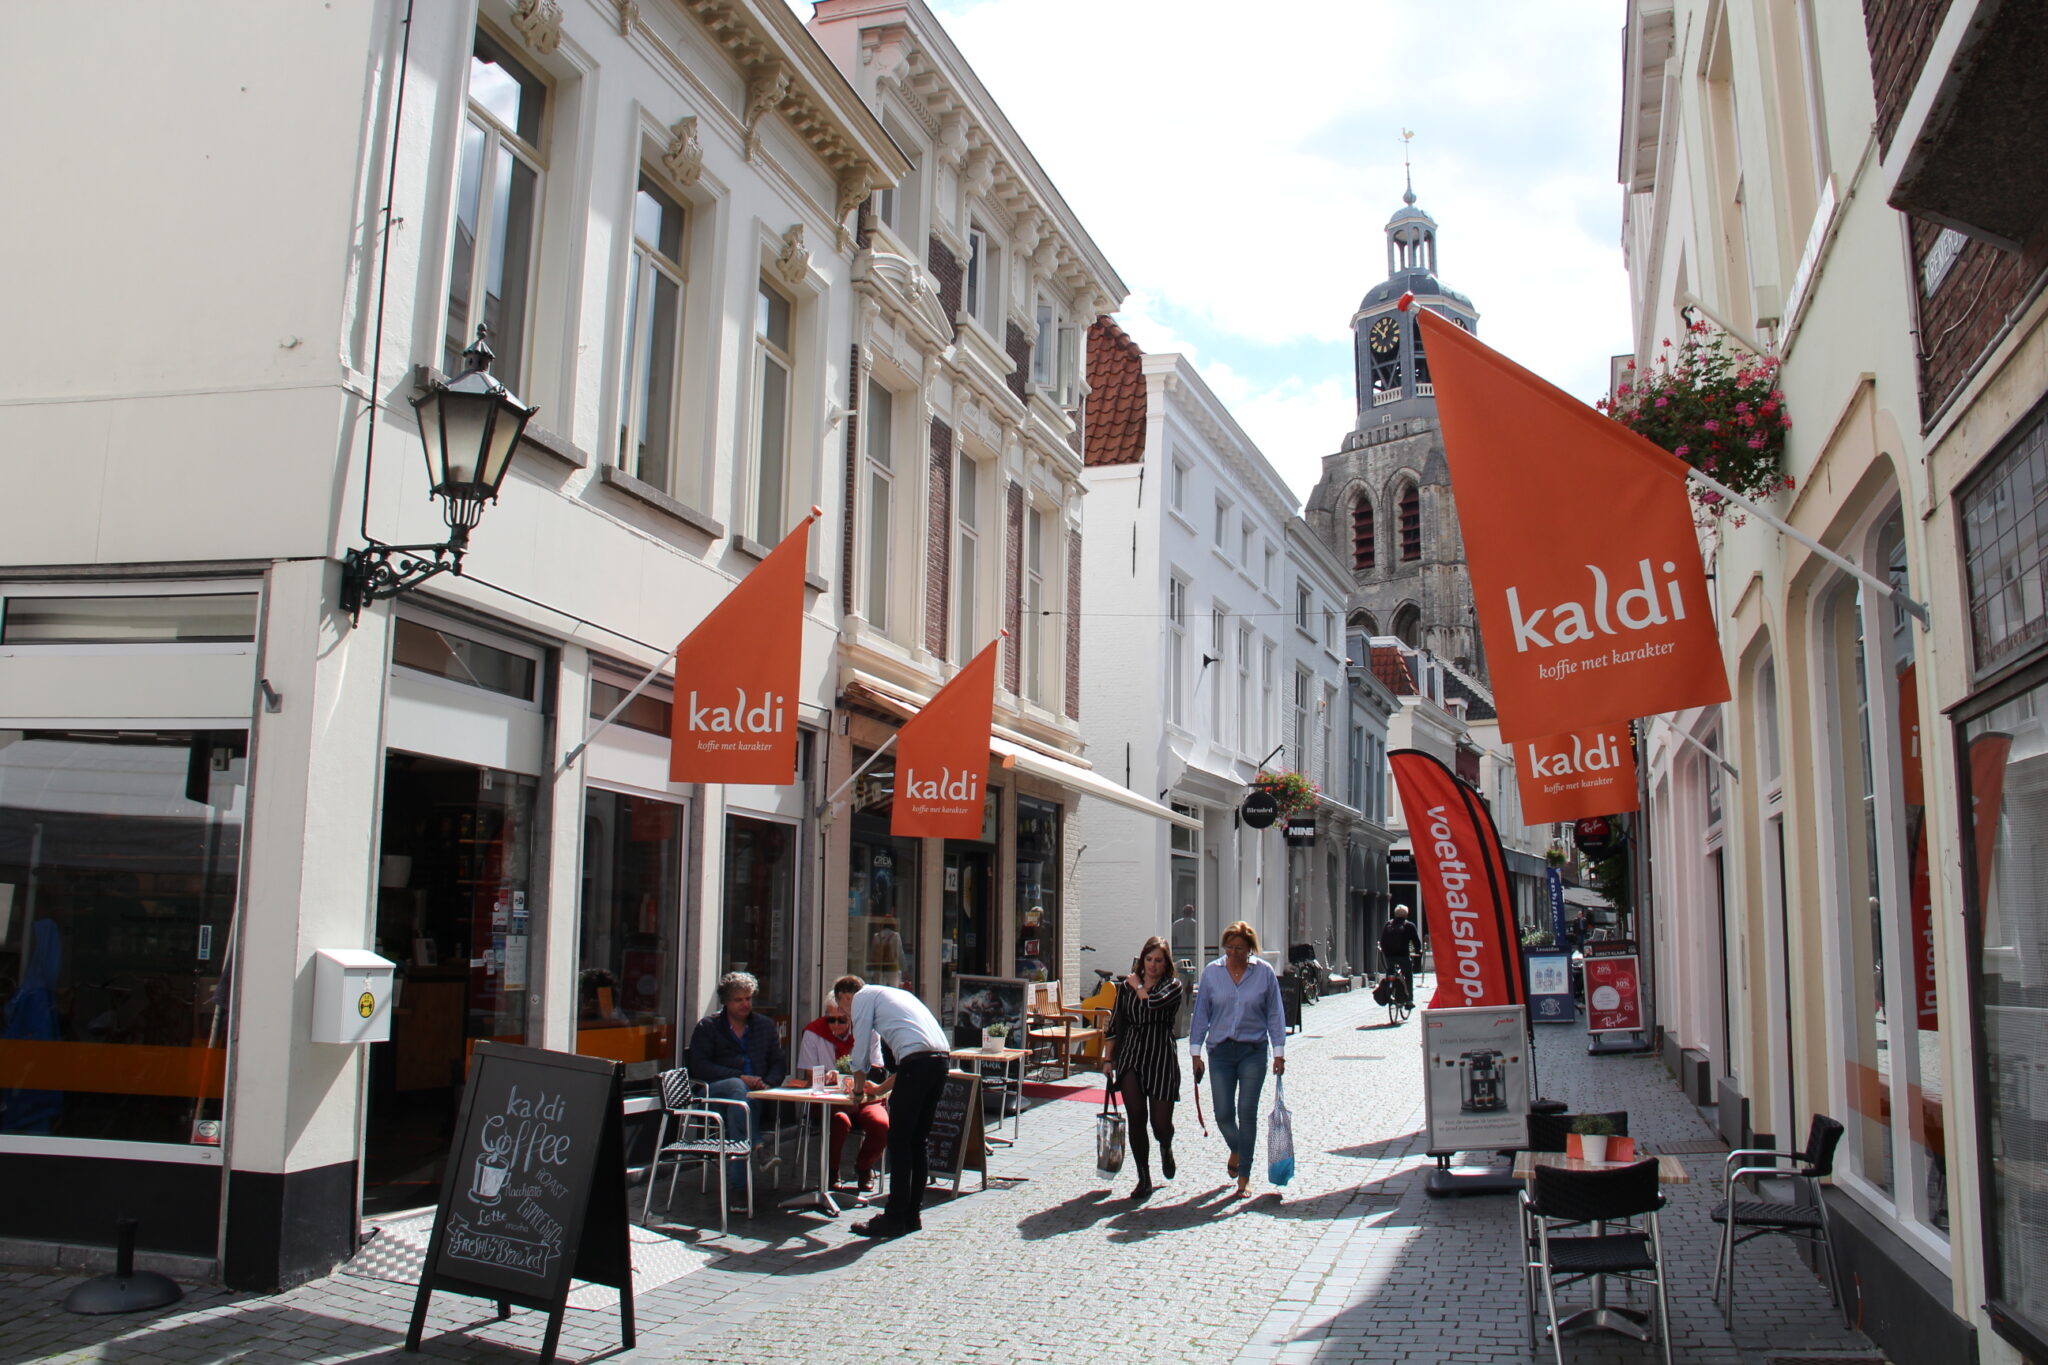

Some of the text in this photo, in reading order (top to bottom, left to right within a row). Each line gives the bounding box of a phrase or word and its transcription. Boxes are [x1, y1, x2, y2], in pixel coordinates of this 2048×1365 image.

[1925, 229, 1962, 292] KREMERS
[1505, 558, 1686, 653] kaldi
[1539, 641, 1676, 680] koffie met karakter
[689, 687, 784, 733] kaldi
[697, 740, 773, 752] koffie met karakter
[1528, 733, 1620, 779] kaldi
[906, 766, 977, 800] kaldi
[1543, 777, 1614, 794] koffie met karakter
[912, 804, 929, 815] koffie
[941, 806, 969, 814] karakter
[1288, 827, 1314, 836] NINE
[1427, 805, 1484, 1006] voetbalshop.
[506, 1085, 566, 1122] kaldi
[481, 1115, 571, 1173] Coffee
